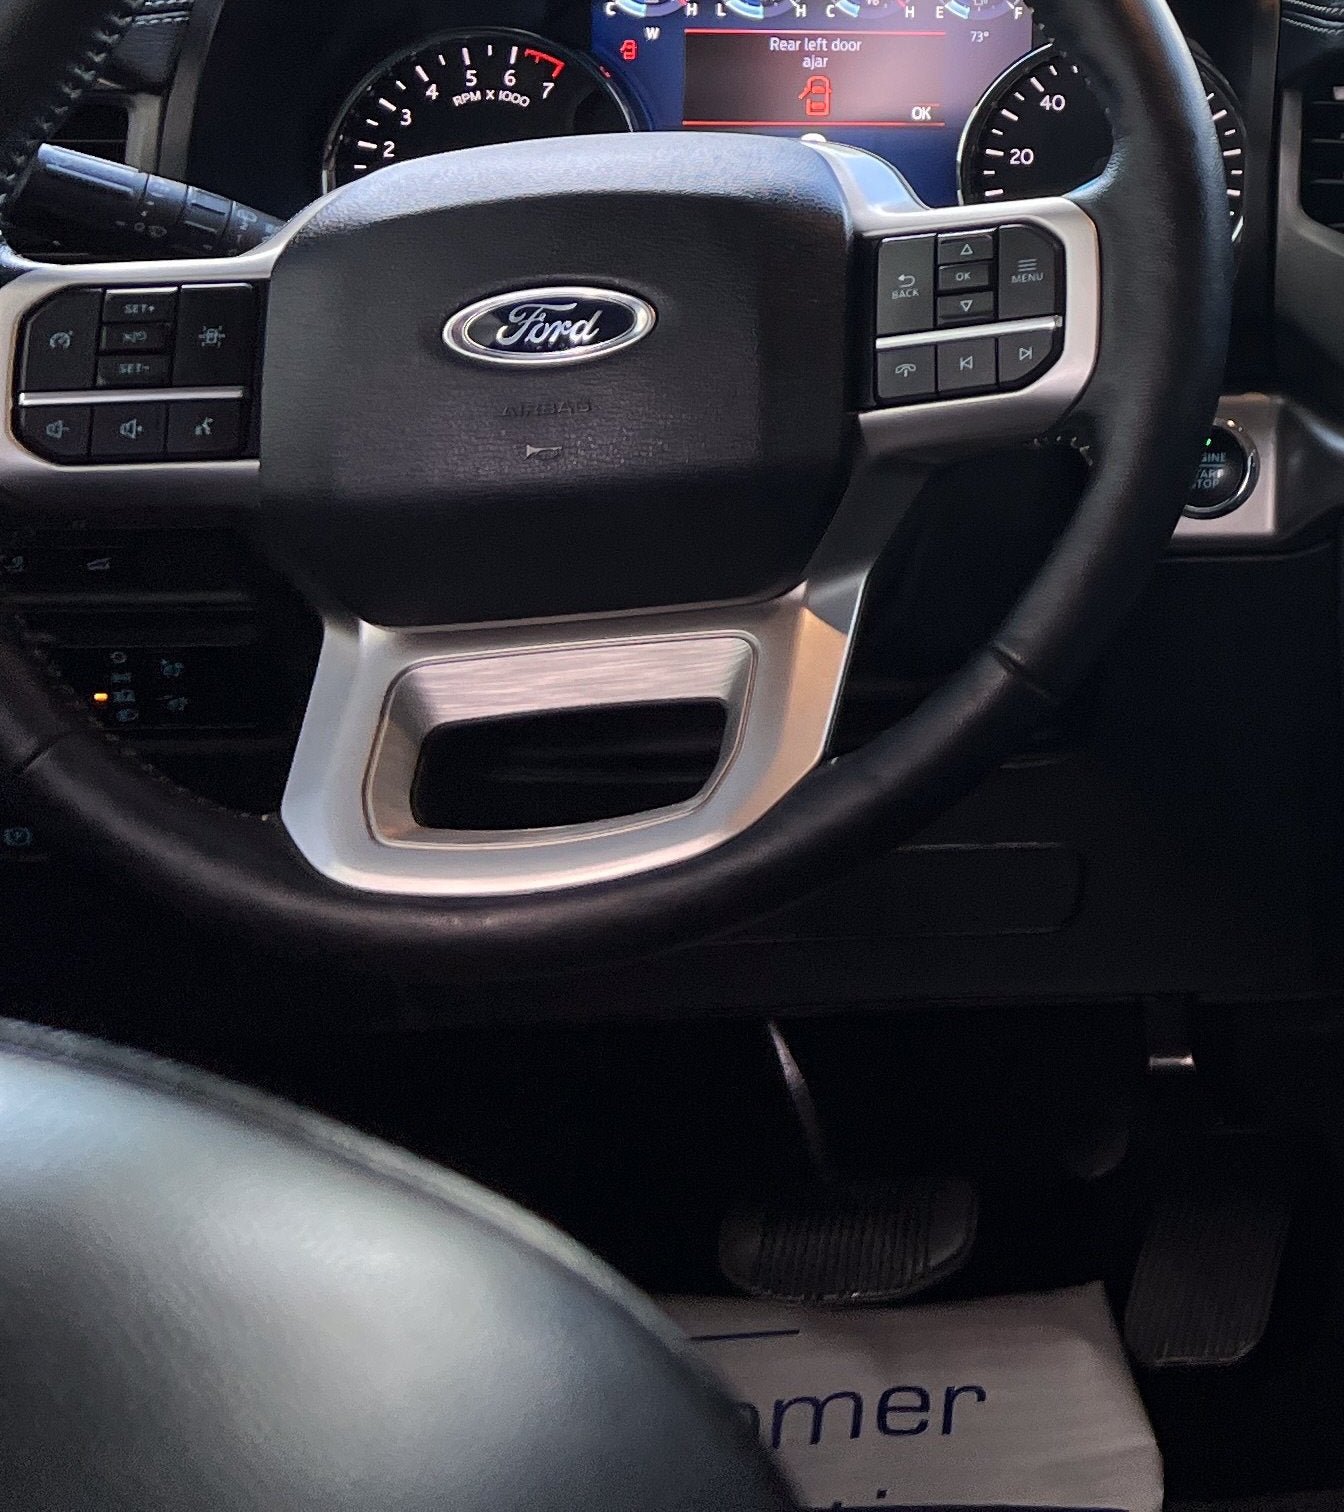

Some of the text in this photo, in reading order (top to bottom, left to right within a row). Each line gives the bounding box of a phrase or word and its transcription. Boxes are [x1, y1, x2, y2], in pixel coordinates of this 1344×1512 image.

[605, 2, 617, 16] C
[685, 3, 698, 17] H
[717, 3, 726, 17] L
[795, 4, 806, 18] H
[826, 4, 836, 18] C
[904, 5, 915, 19] H
[936, 5, 945, 19] E
[1014, 6, 1023, 20] F
[645, 27, 661, 40] W
[970, 30, 990, 43] 73°
[769, 37, 862, 53] Rear left door
[802, 54, 829, 70] ajar
[465, 70, 477, 86] 5
[504, 69, 516, 86] 6
[425, 83, 439, 100] 4
[542, 82, 555, 99] 7
[452, 90, 482, 106] RPM
[499, 89, 530, 107] 1000
[1040, 94, 1066, 111] 40
[400, 109, 412, 126] 3
[911, 106, 931, 121] OK
[383, 141, 395, 158] 2
[1009, 148, 1034, 165] 20
[955, 272, 972, 281] OK
[1011, 272, 1044, 284] MENU
[891, 288, 919, 300] BACK
[496, 302, 604, 346] Ford
